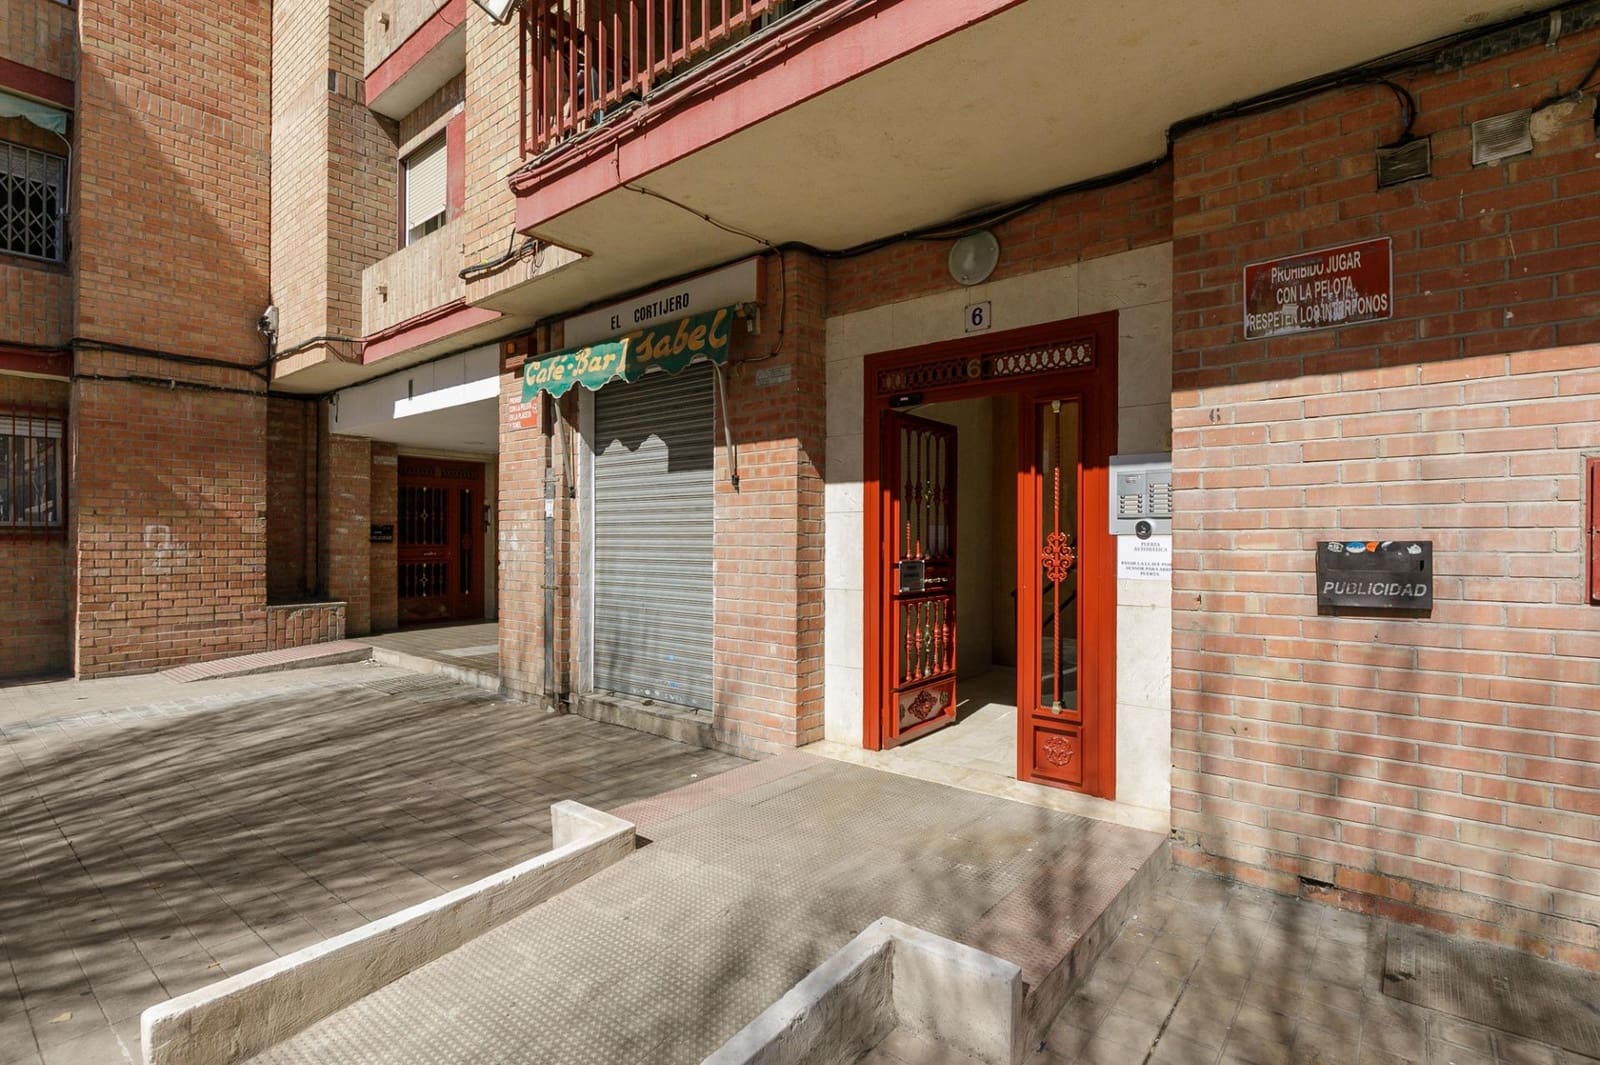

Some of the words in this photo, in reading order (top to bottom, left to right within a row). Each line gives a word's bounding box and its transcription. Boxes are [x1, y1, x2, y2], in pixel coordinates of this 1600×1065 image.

[1326, 251, 1361, 273] JUGAR
[1276, 286, 1297, 304] CON
[1300, 282, 1312, 301] LA
[611, 314, 622, 330] EL
[634, 293, 690, 322] CORTIJERO
[972, 308, 983, 326] 6
[1249, 308, 1298, 332] RESPETEN
[966, 358, 981, 378] 6
[1209, 408, 1222, 422] 6
[1323, 581, 1428, 597] PUBLICIDAD
